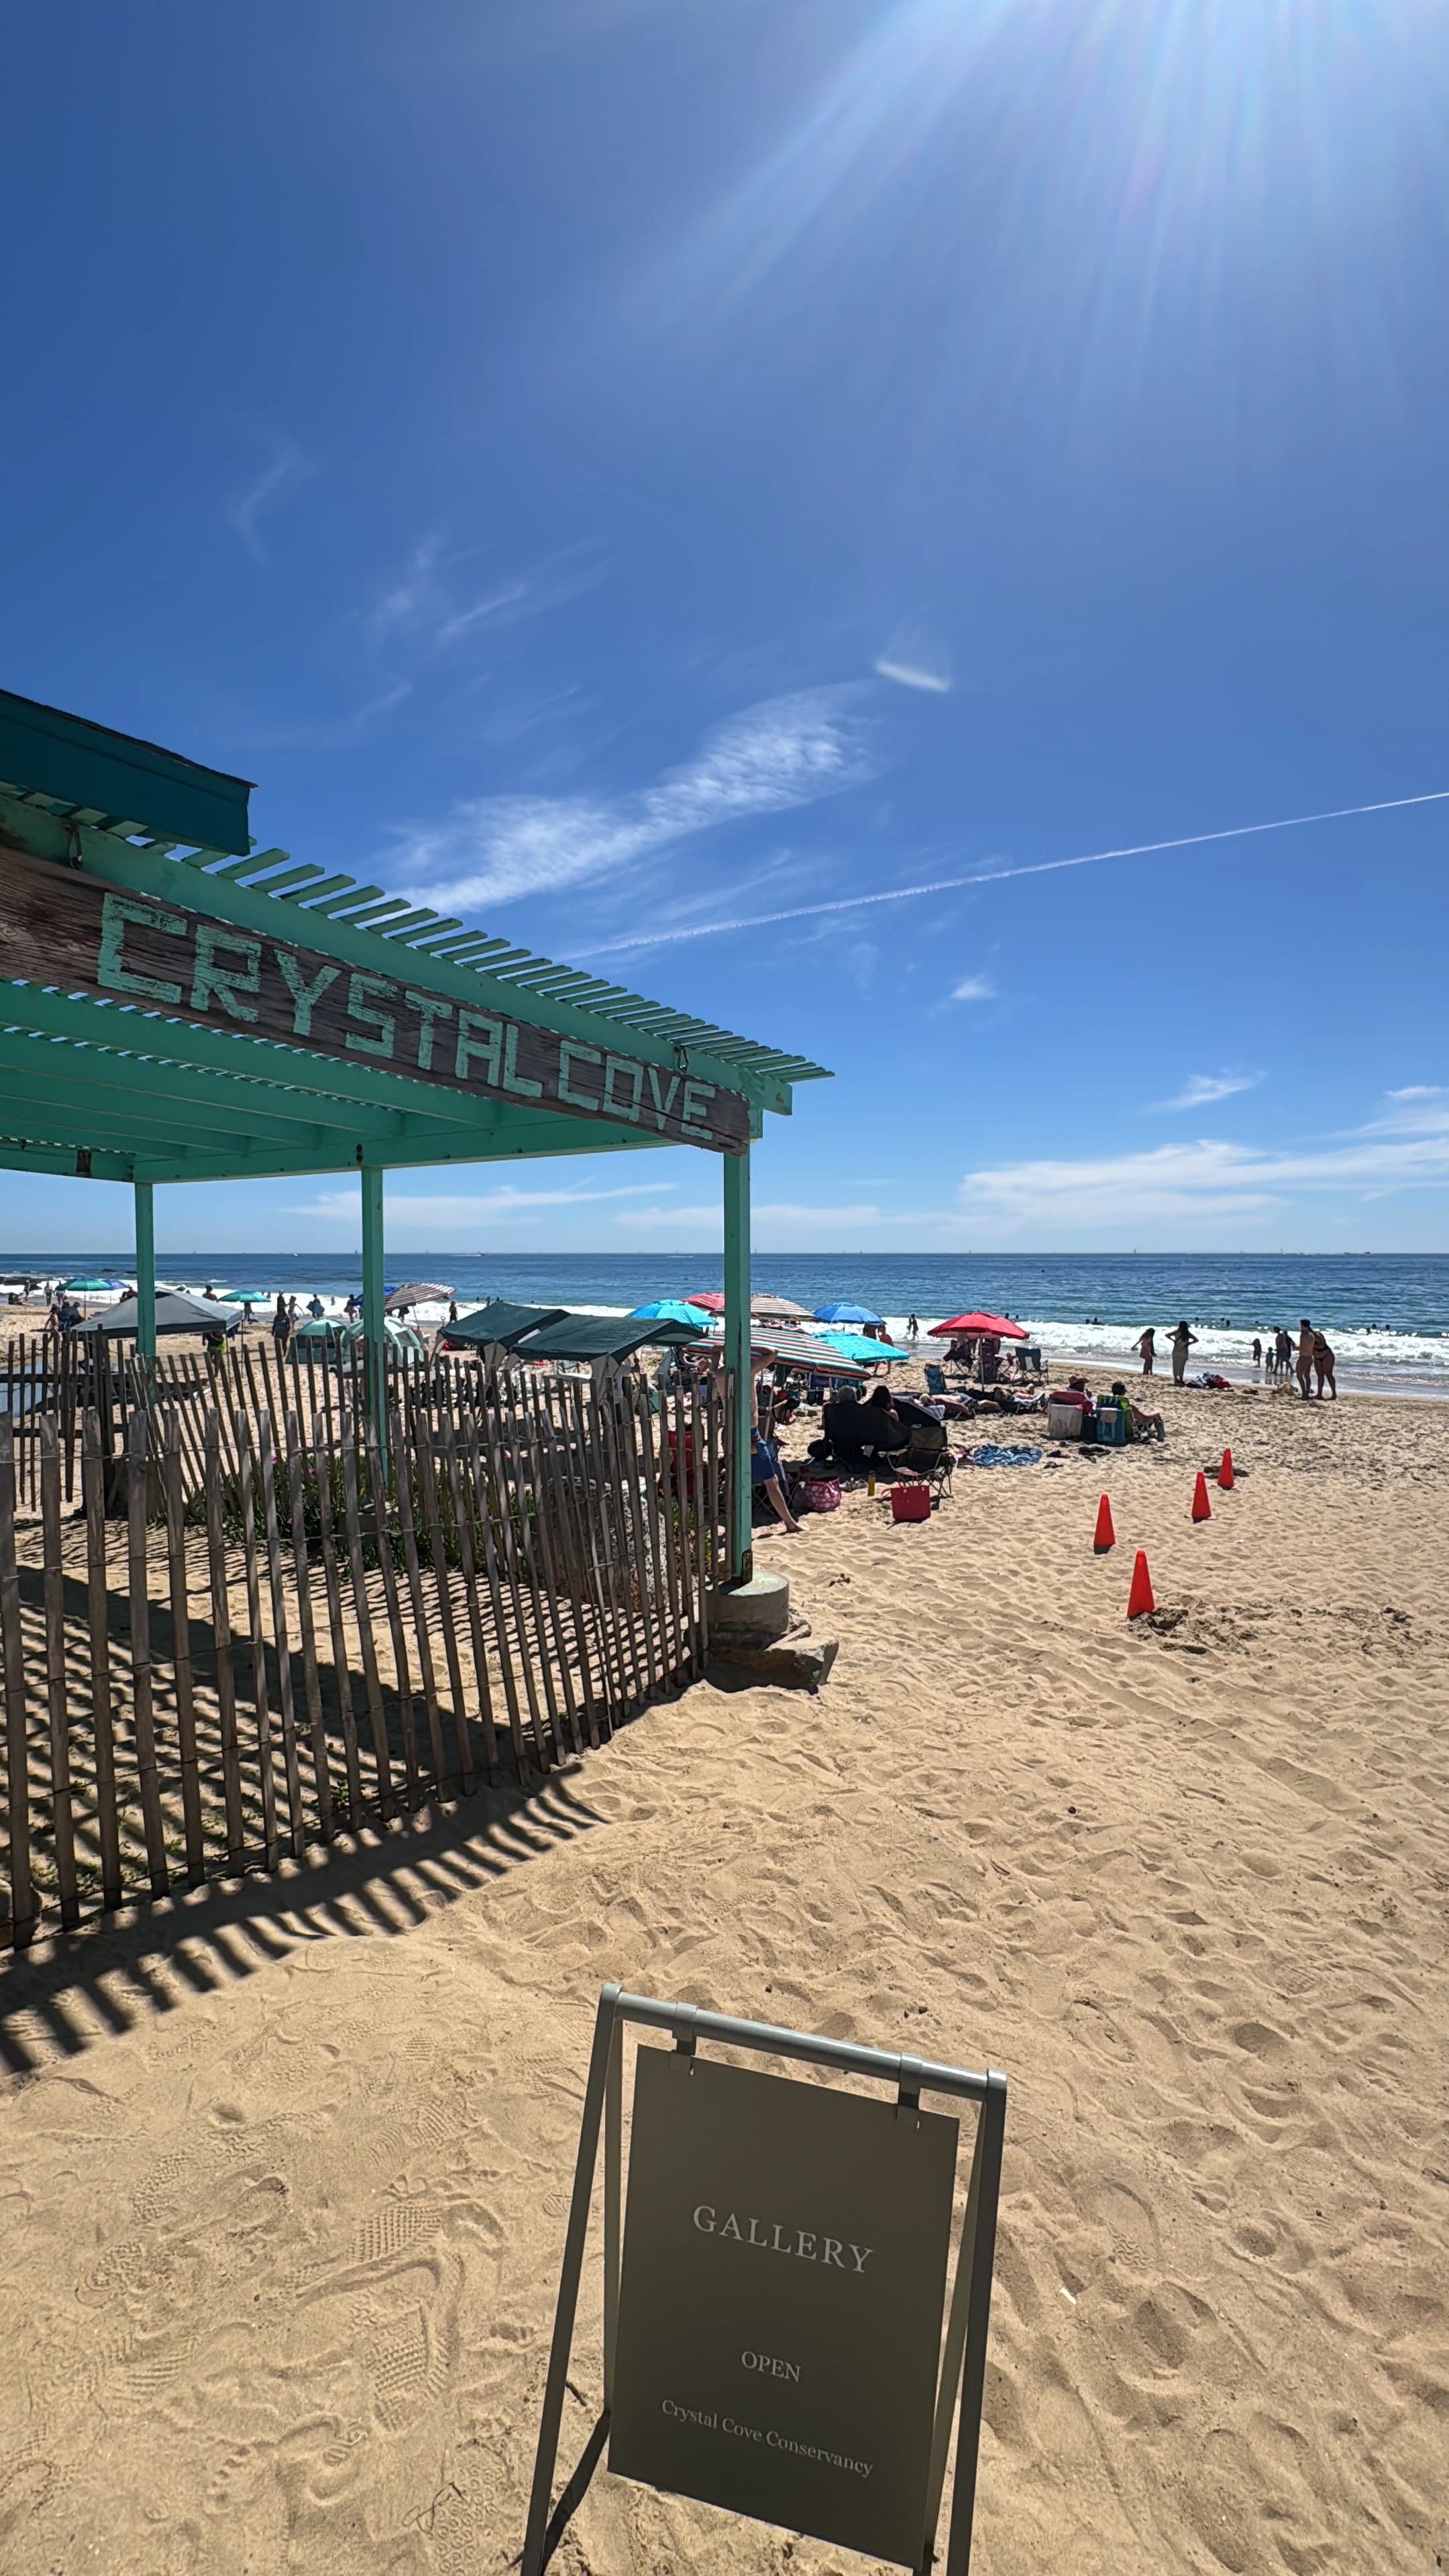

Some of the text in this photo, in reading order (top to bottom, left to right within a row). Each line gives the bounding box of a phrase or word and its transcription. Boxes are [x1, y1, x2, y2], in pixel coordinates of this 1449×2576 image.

[97, 892, 716, 1140] CRYSTAL COVE
[693, 2205, 873, 2273] GALLERY
[741, 2351, 802, 2383] OPEN
[662, 2399, 873, 2478] Crystal Cove Conservancy
